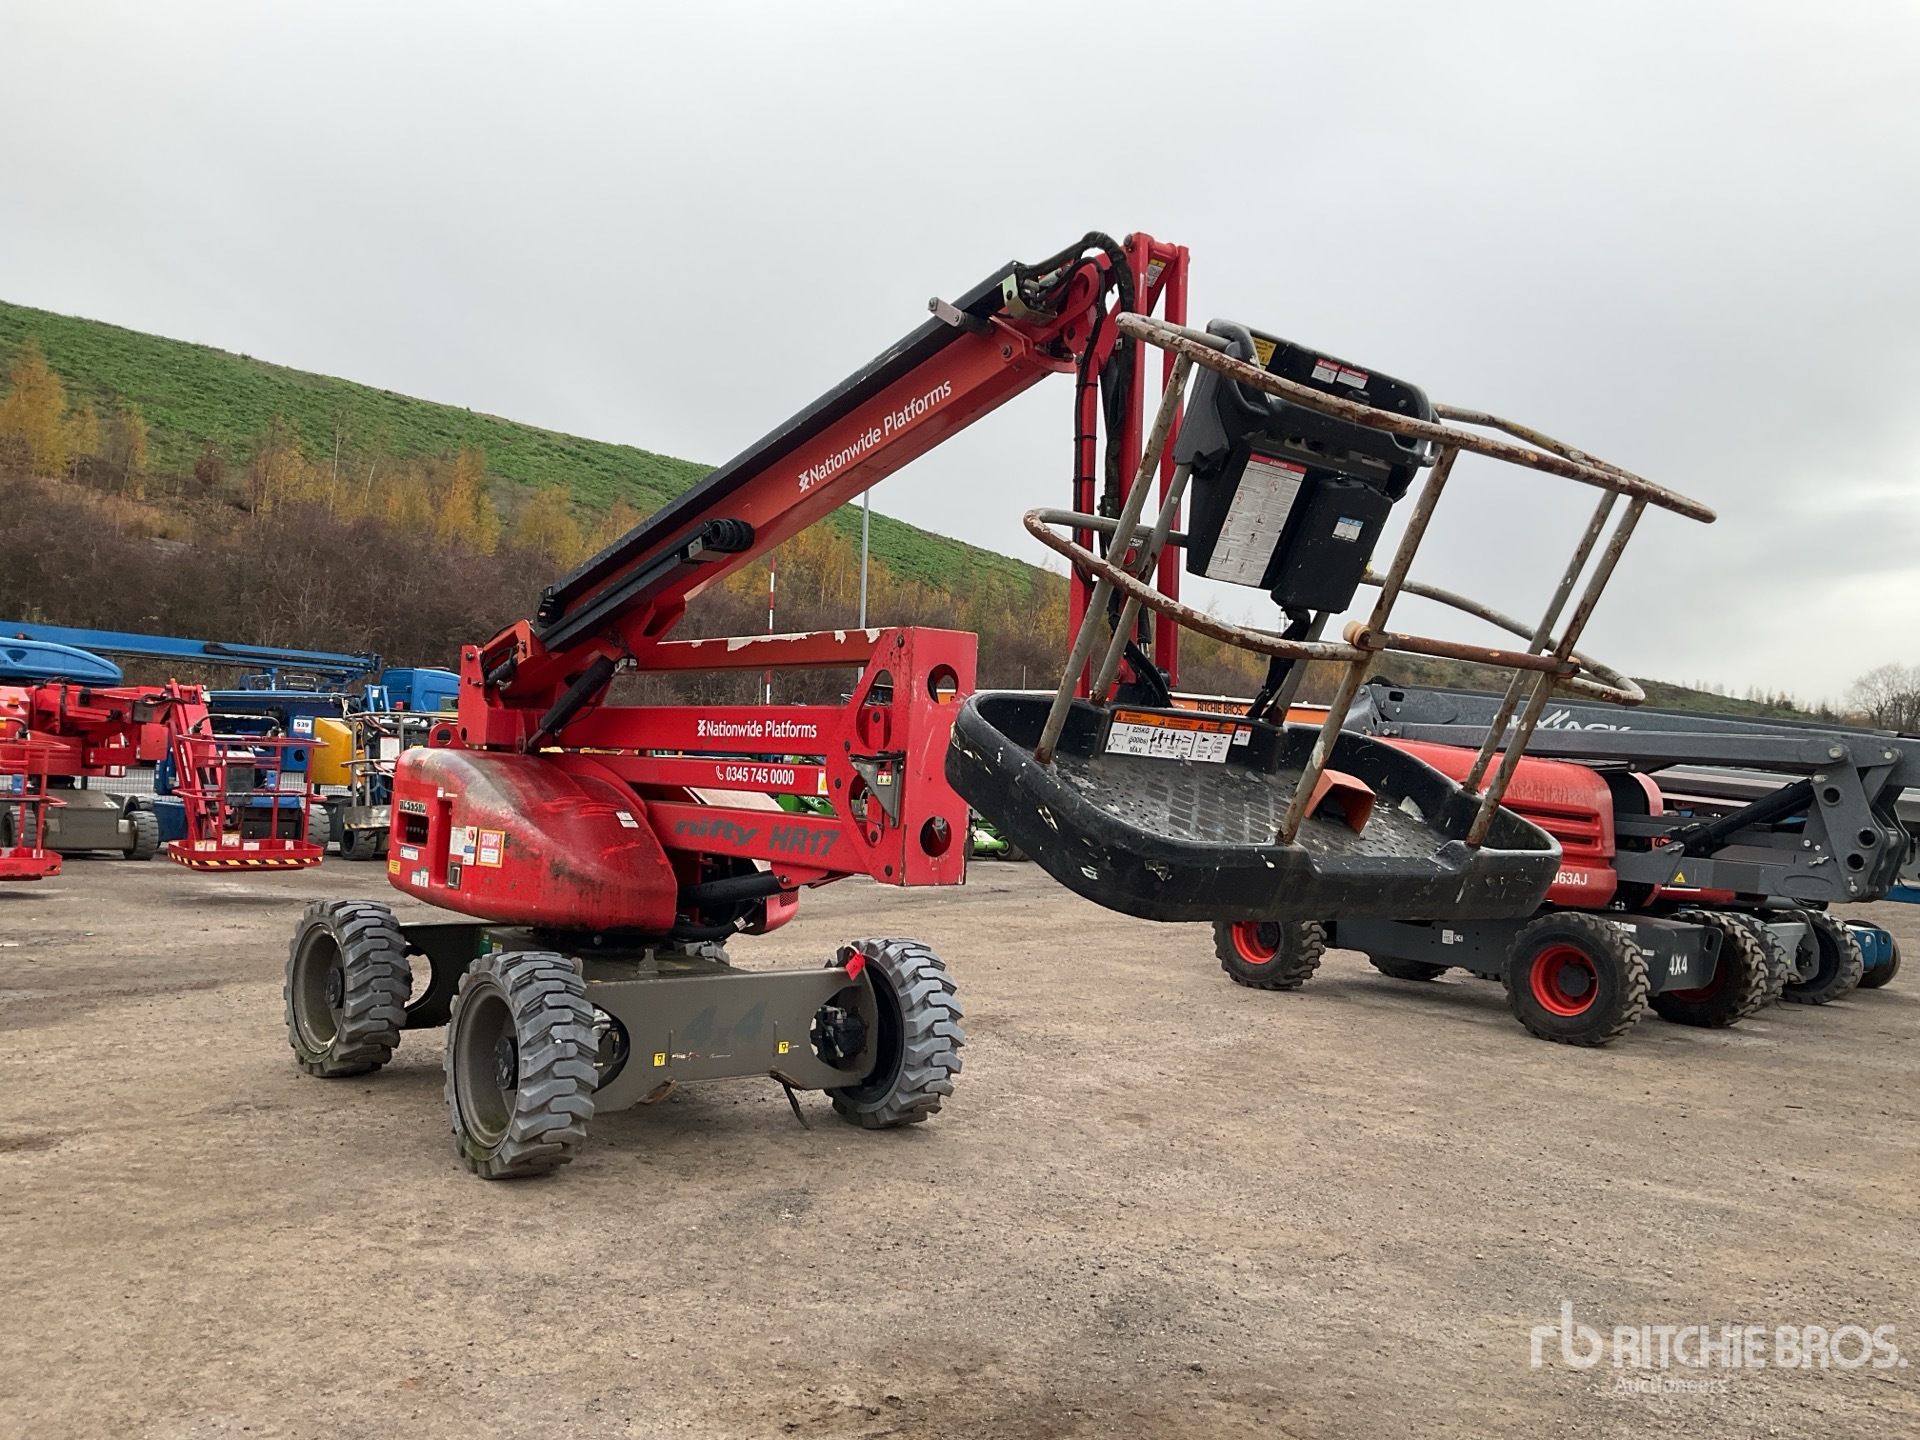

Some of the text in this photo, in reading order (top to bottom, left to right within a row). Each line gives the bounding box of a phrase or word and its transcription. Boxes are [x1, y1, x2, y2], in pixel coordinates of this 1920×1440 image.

[810, 380, 952, 485] Nationwide Platforms
[706, 720, 817, 738] Nationwide Platforms
[725, 766, 795, 786] 0345 745 0000
[481, 832, 501, 847] STOP!
[674, 817, 759, 846] nifty
[768, 824, 841, 857] HR17
